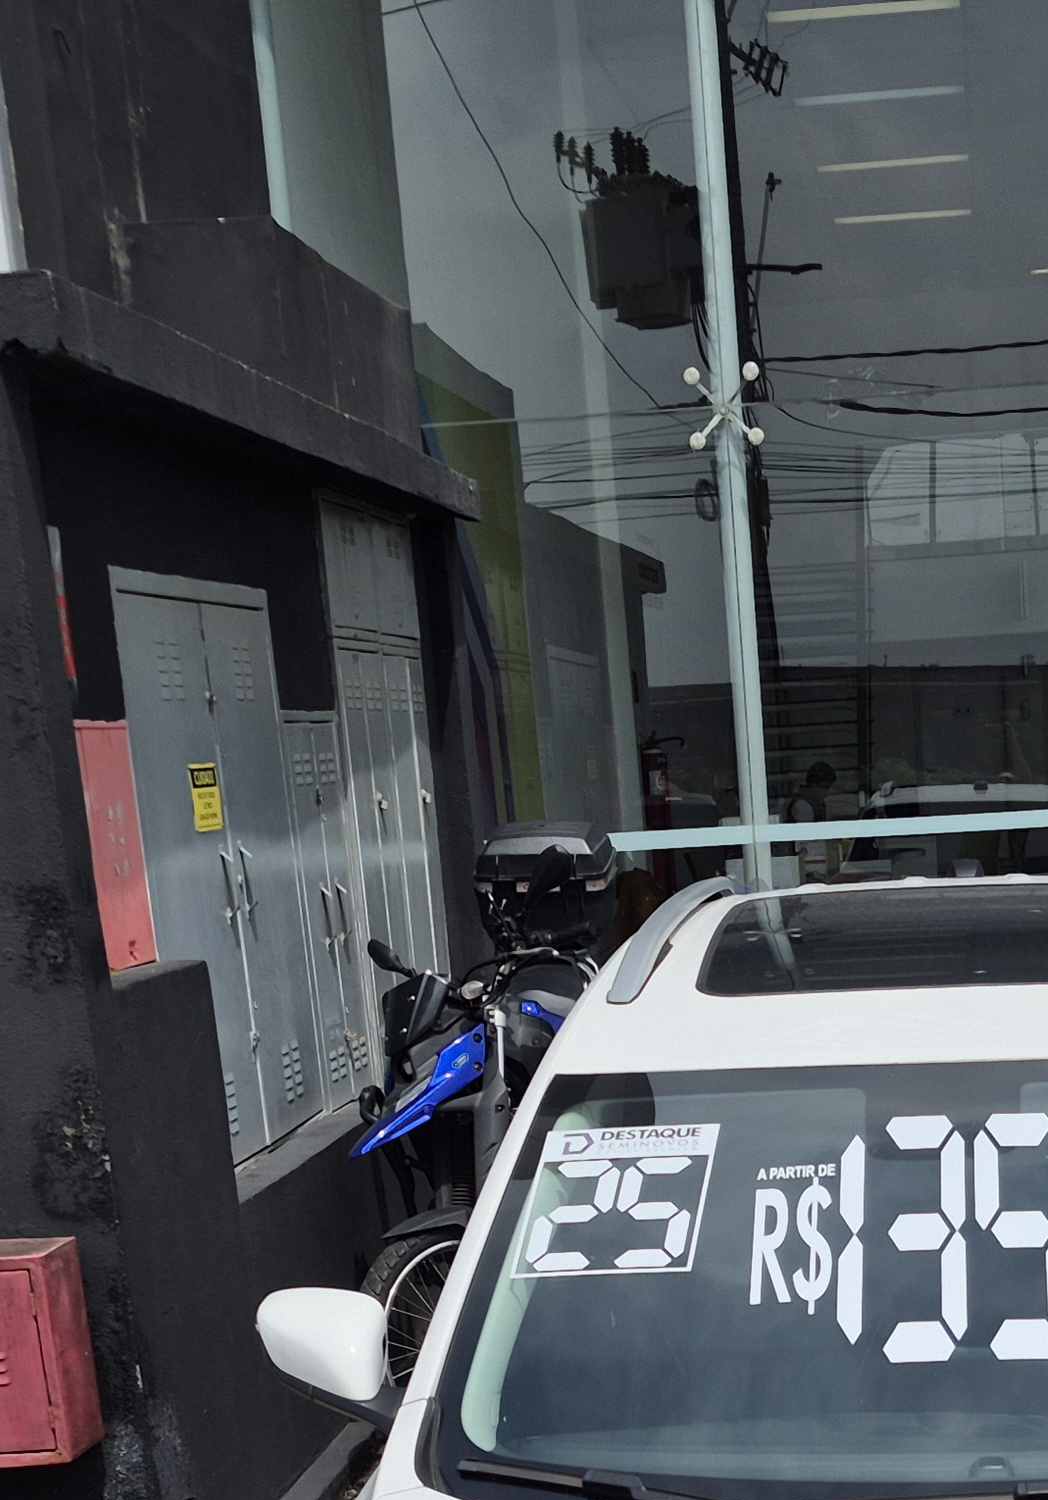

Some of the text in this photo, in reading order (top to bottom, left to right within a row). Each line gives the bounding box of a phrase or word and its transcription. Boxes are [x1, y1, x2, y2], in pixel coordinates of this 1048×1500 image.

[600, 1127, 702, 1141] DESTAQUE
[597, 1139, 700, 1150] SEMINOVOS
[757, 1163, 836, 1181] A PARTIR DE
[525, 1156, 693, 1272] 25
[749, 1176, 833, 1315] R$
